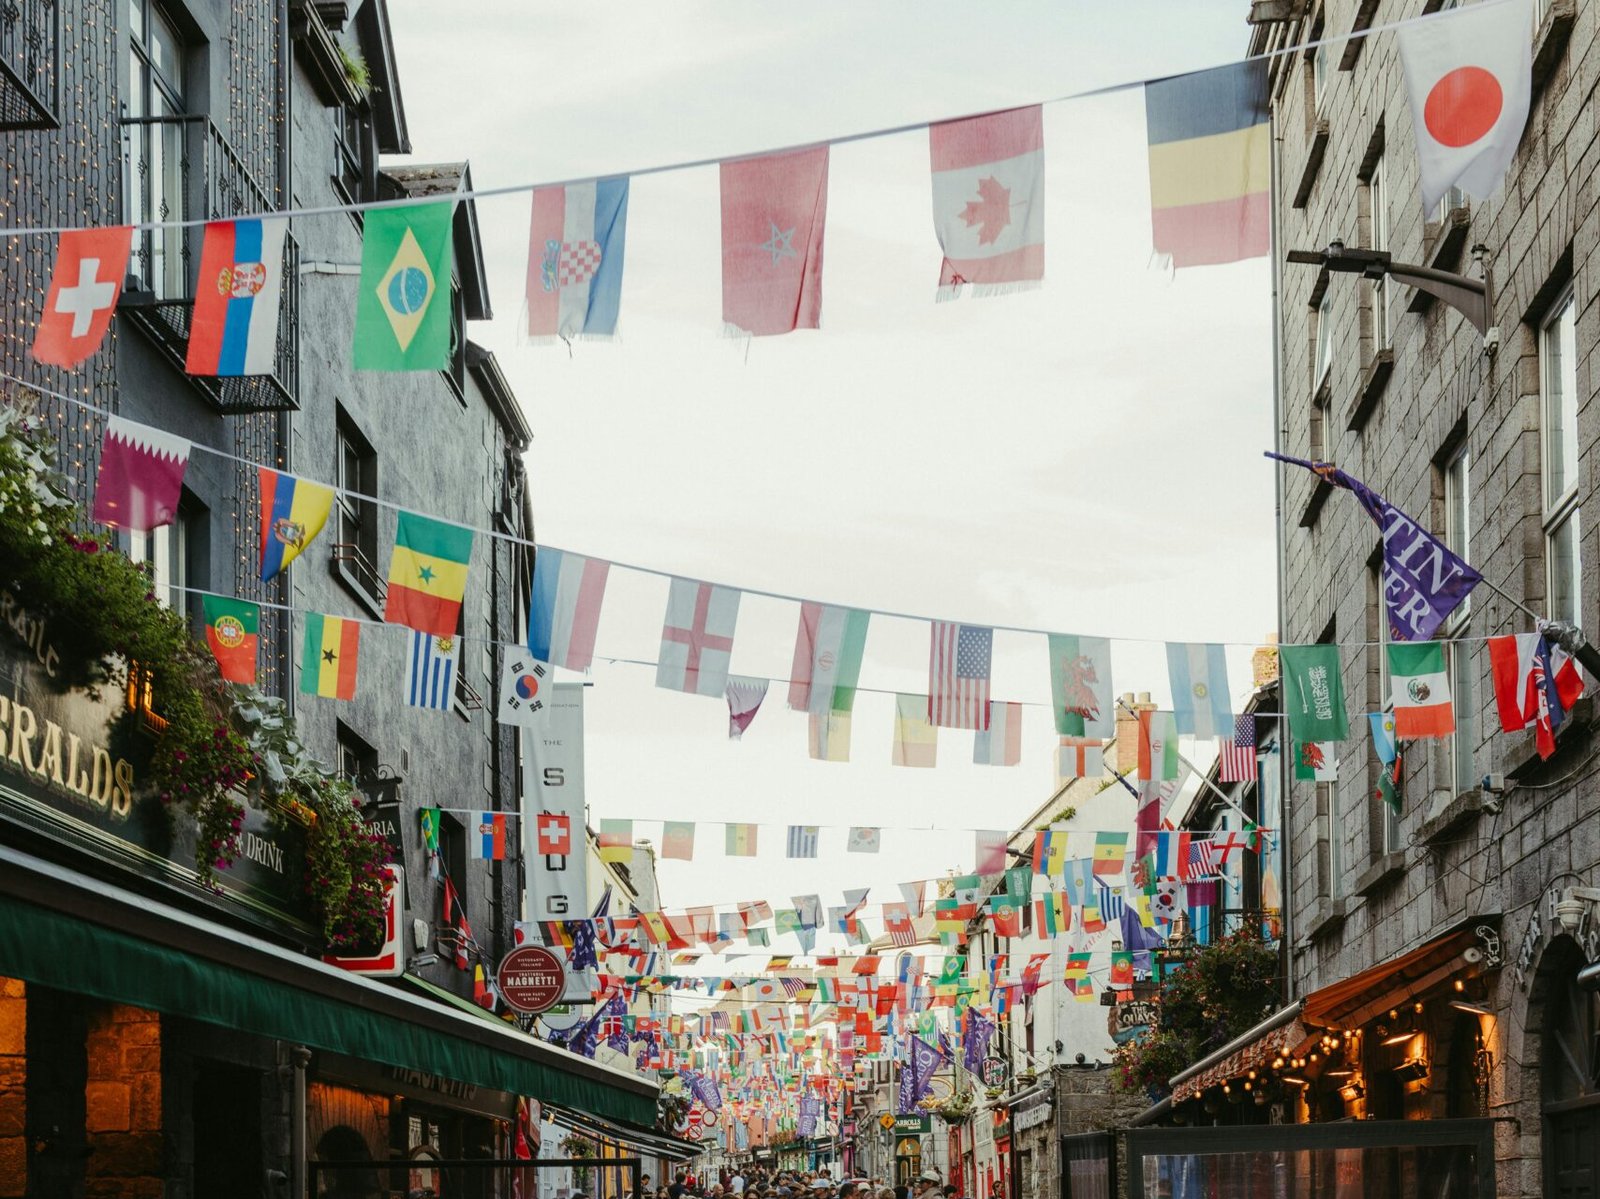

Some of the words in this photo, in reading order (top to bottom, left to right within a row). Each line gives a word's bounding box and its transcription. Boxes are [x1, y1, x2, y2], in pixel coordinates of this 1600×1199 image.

[1385, 559, 1432, 635] ER
[246, 832, 284, 875] DRINK
[543, 767, 568, 914] SUG
[507, 976, 556, 986] MAGNETTI
